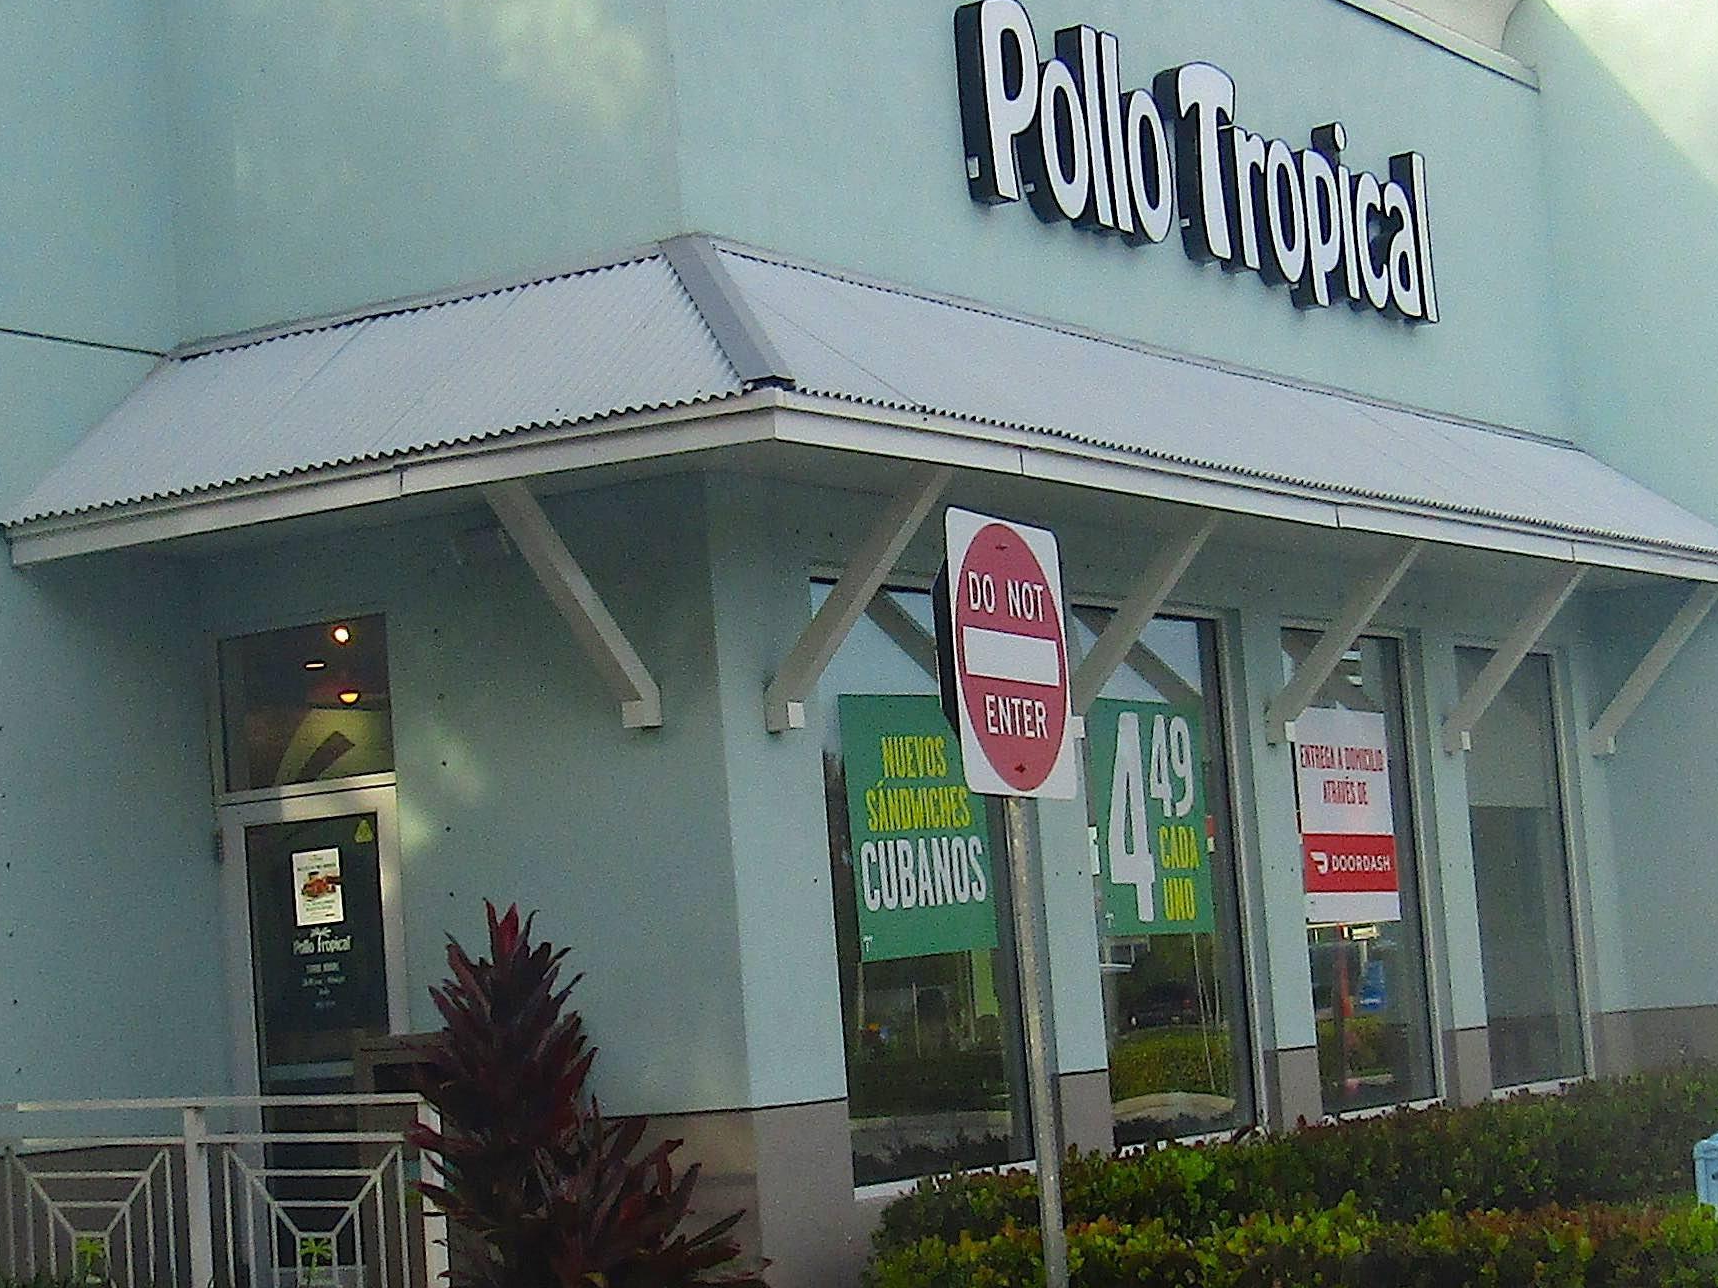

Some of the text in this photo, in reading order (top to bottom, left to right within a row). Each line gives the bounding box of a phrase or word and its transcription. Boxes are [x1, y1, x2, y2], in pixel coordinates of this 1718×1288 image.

[1157, 62, 1440, 323] Tropical
[968, 570, 1045, 623] DO NOT
[985, 695, 1049, 739] ENTER
[882, 735, 948, 779] NUEVOS
[1300, 744, 1334, 769] ENTREGA
[866, 780, 972, 832] SÁNDWICHES
[1358, 781, 1368, 805] DE
[1158, 826, 1199, 869] CADA
[1332, 855, 1390, 872] DOORDASH
[860, 835, 987, 911] CUBANOS
[1163, 878, 1196, 920] UNO
